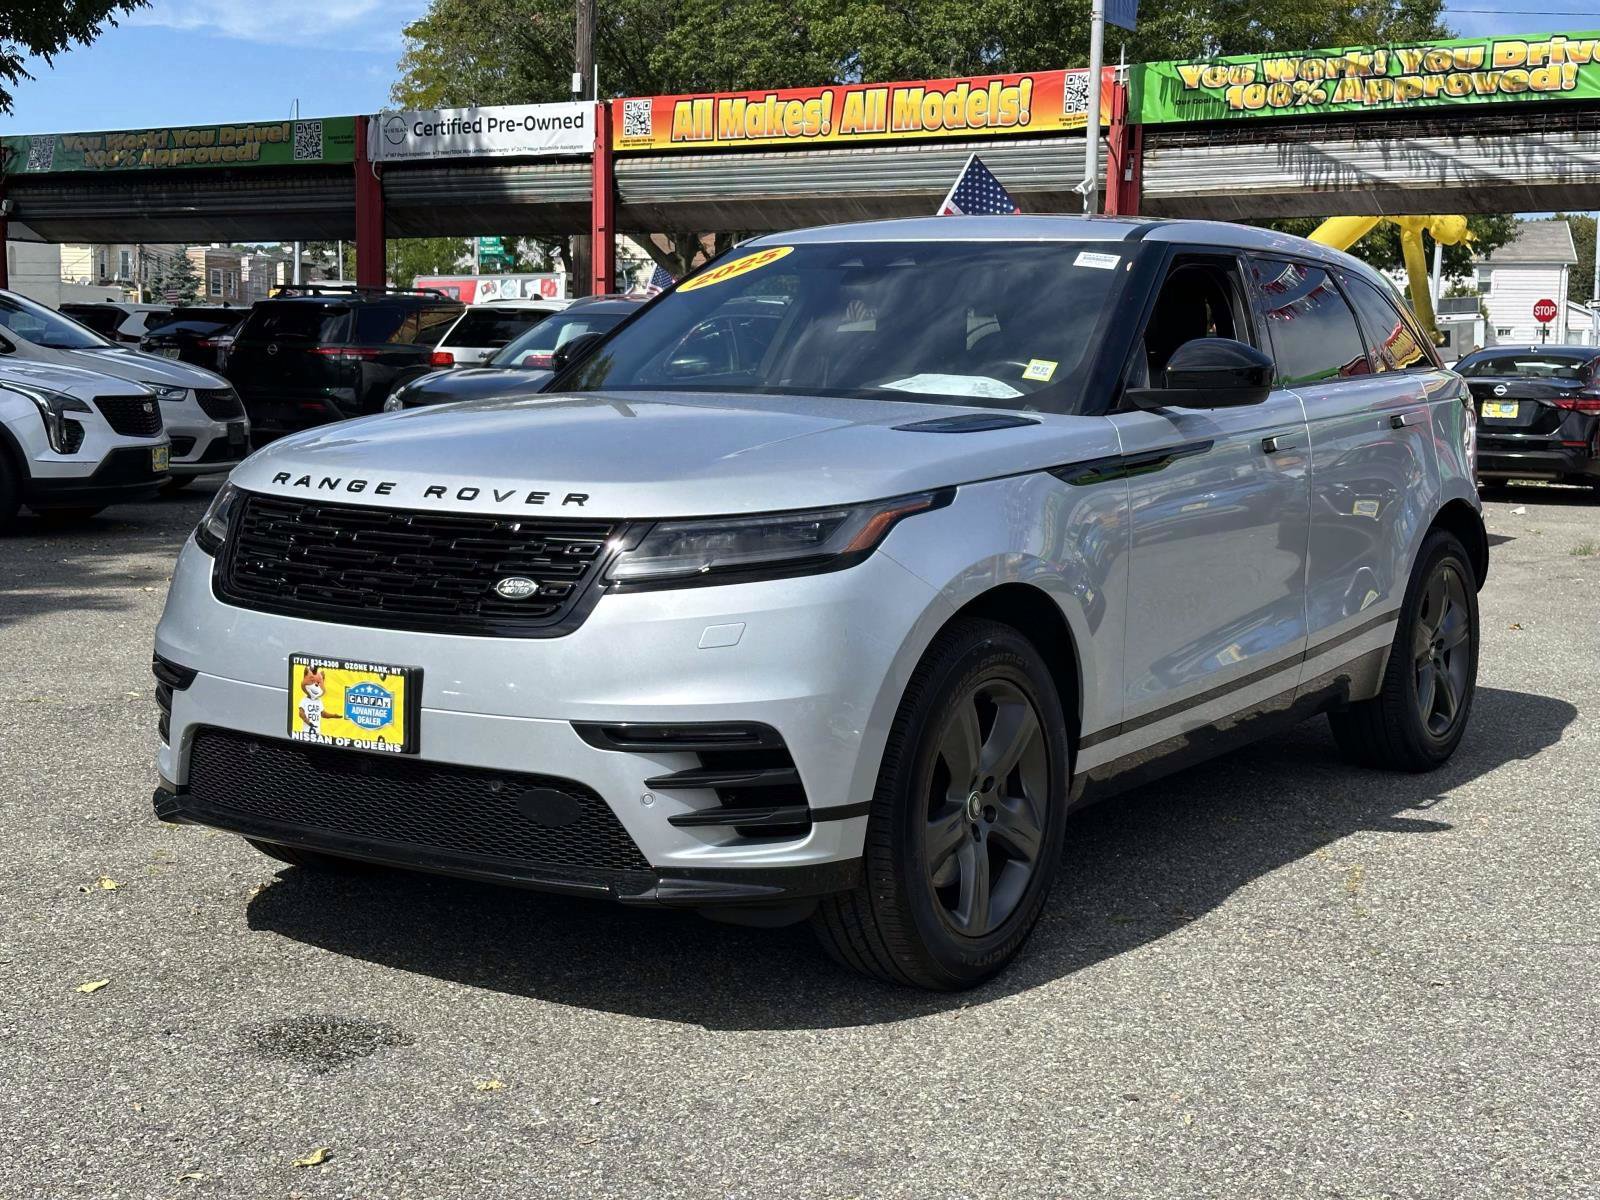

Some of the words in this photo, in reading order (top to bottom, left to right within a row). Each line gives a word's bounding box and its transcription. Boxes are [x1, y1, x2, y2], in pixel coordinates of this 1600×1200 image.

[1174, 64, 1256, 91] You
[1260, 48, 1389, 86] Work!
[1399, 45, 1488, 75] You
[1224, 79, 1327, 112] 100%
[1332, 62, 1579, 107] Approved!
[671, 97, 714, 142] All
[717, 90, 834, 141] Makes!
[840, 87, 888, 136] All
[891, 77, 1035, 134] Models!
[384, 126, 409, 134] NISSAN
[413, 117, 482, 138] Certified
[487, 112, 584, 134] Pre-Owned
[63, 135, 102, 153] You
[104, 130, 169, 151] Work!
[173, 126, 217, 147] You
[219, 122, 291, 144] Drive!
[84, 147, 136, 168] 100%
[138, 141, 260, 168] Approved!
[688, 249, 782, 289] 2025
[1534, 305, 1556, 317] STOP
[271, 471, 397, 496] RANGE
[423, 485, 590, 507] ROVER
[503, 579, 525, 587] LAND
[503, 586, 530, 594] ROVER
[293, 656, 310, 666] (718)
[344, 662, 368, 671] OZONE
[369, 664, 390, 674] PARK,
[391, 667, 401, 675] NY
[349, 695, 391, 708] CARFAX
[351, 706, 388, 718] ADVANTAGE
[357, 715, 381, 726] DEALER
[291, 731, 333, 746] NISSAN
[335, 738, 350, 747] OF
[353, 740, 402, 753] QUEENS
